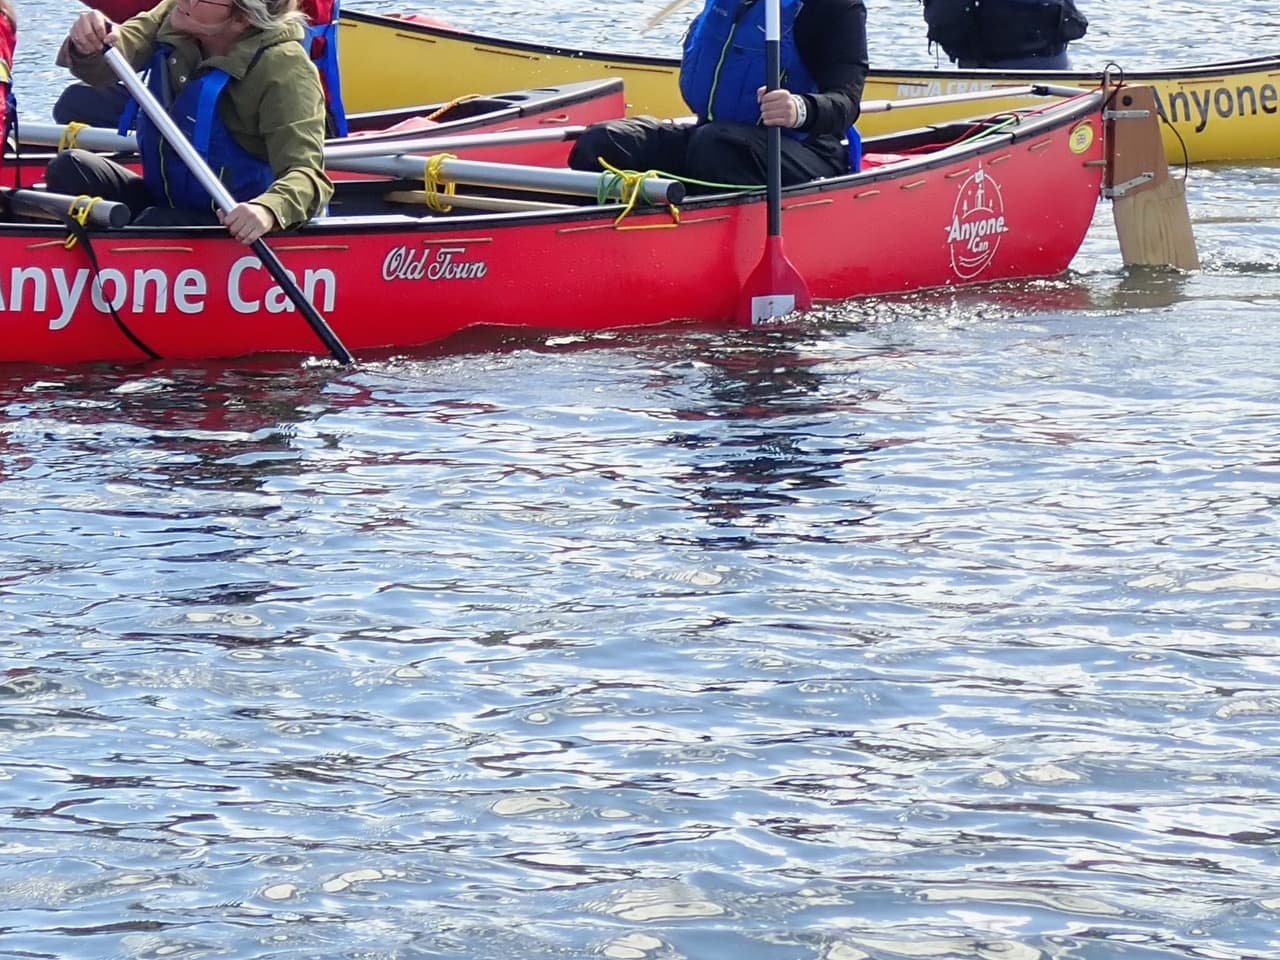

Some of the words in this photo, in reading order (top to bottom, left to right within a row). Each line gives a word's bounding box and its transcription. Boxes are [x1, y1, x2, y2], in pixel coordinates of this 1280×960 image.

[947, 214, 1005, 250] Anyone
[971, 237, 989, 252] Can
[382, 245, 425, 281] Old
[427, 247, 488, 280] Town
[227, 255, 337, 314] Can
